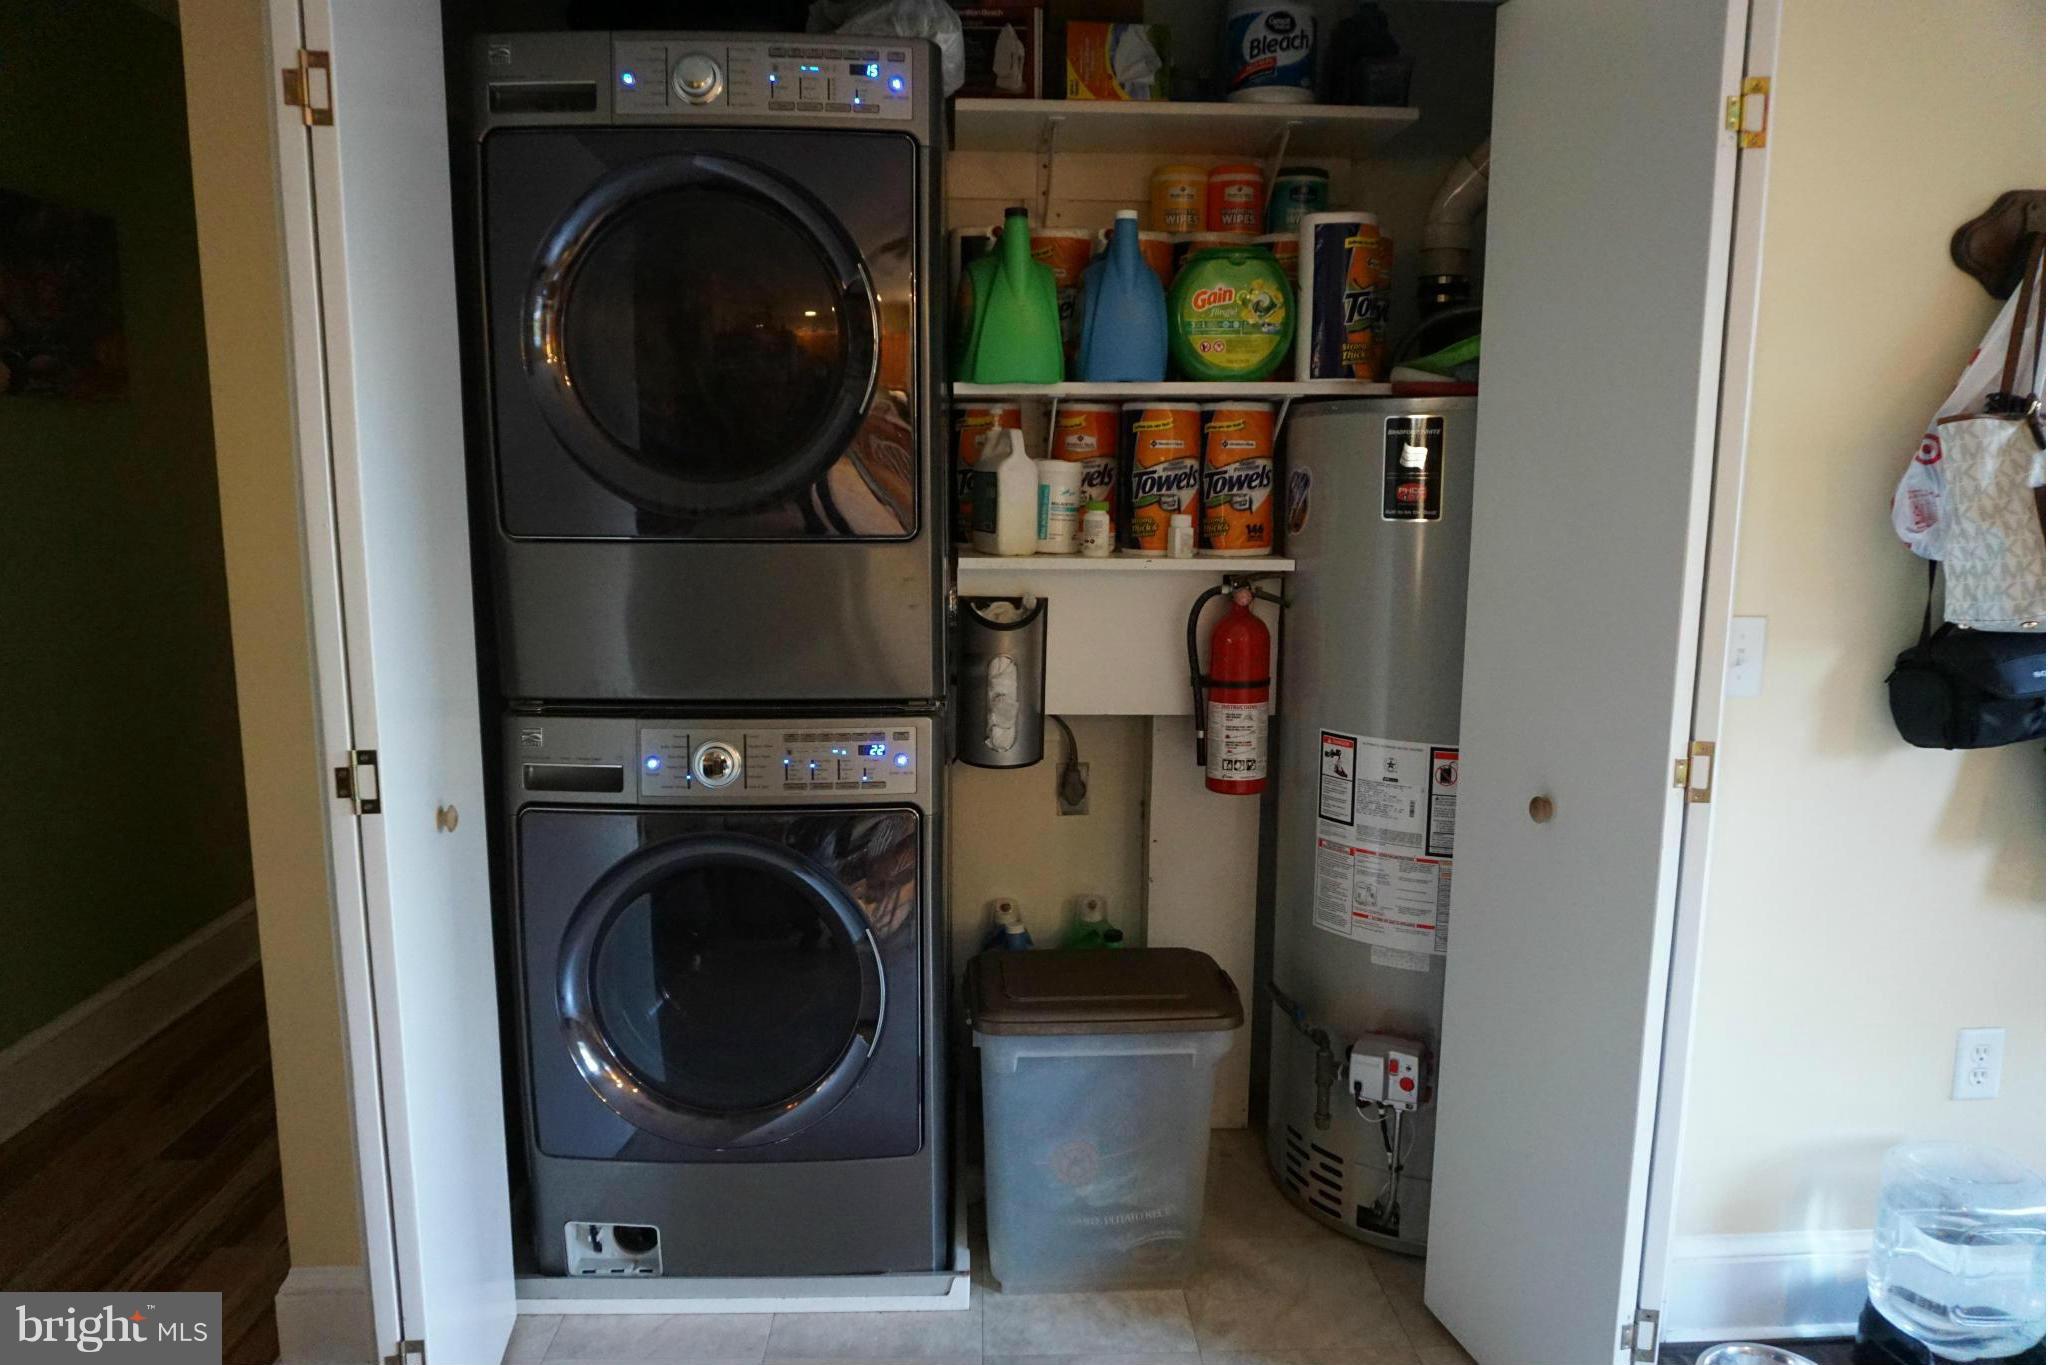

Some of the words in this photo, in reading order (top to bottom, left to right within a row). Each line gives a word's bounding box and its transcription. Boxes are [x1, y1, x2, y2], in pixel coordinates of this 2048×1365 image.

[1249, 29, 1310, 59] Bleach
[1221, 214, 1255, 225] WIPES
[1192, 286, 1235, 311] Gain
[1132, 464, 1198, 500] Towels
[1204, 464, 1271, 500] Towels
[868, 744, 884, 757] 22
